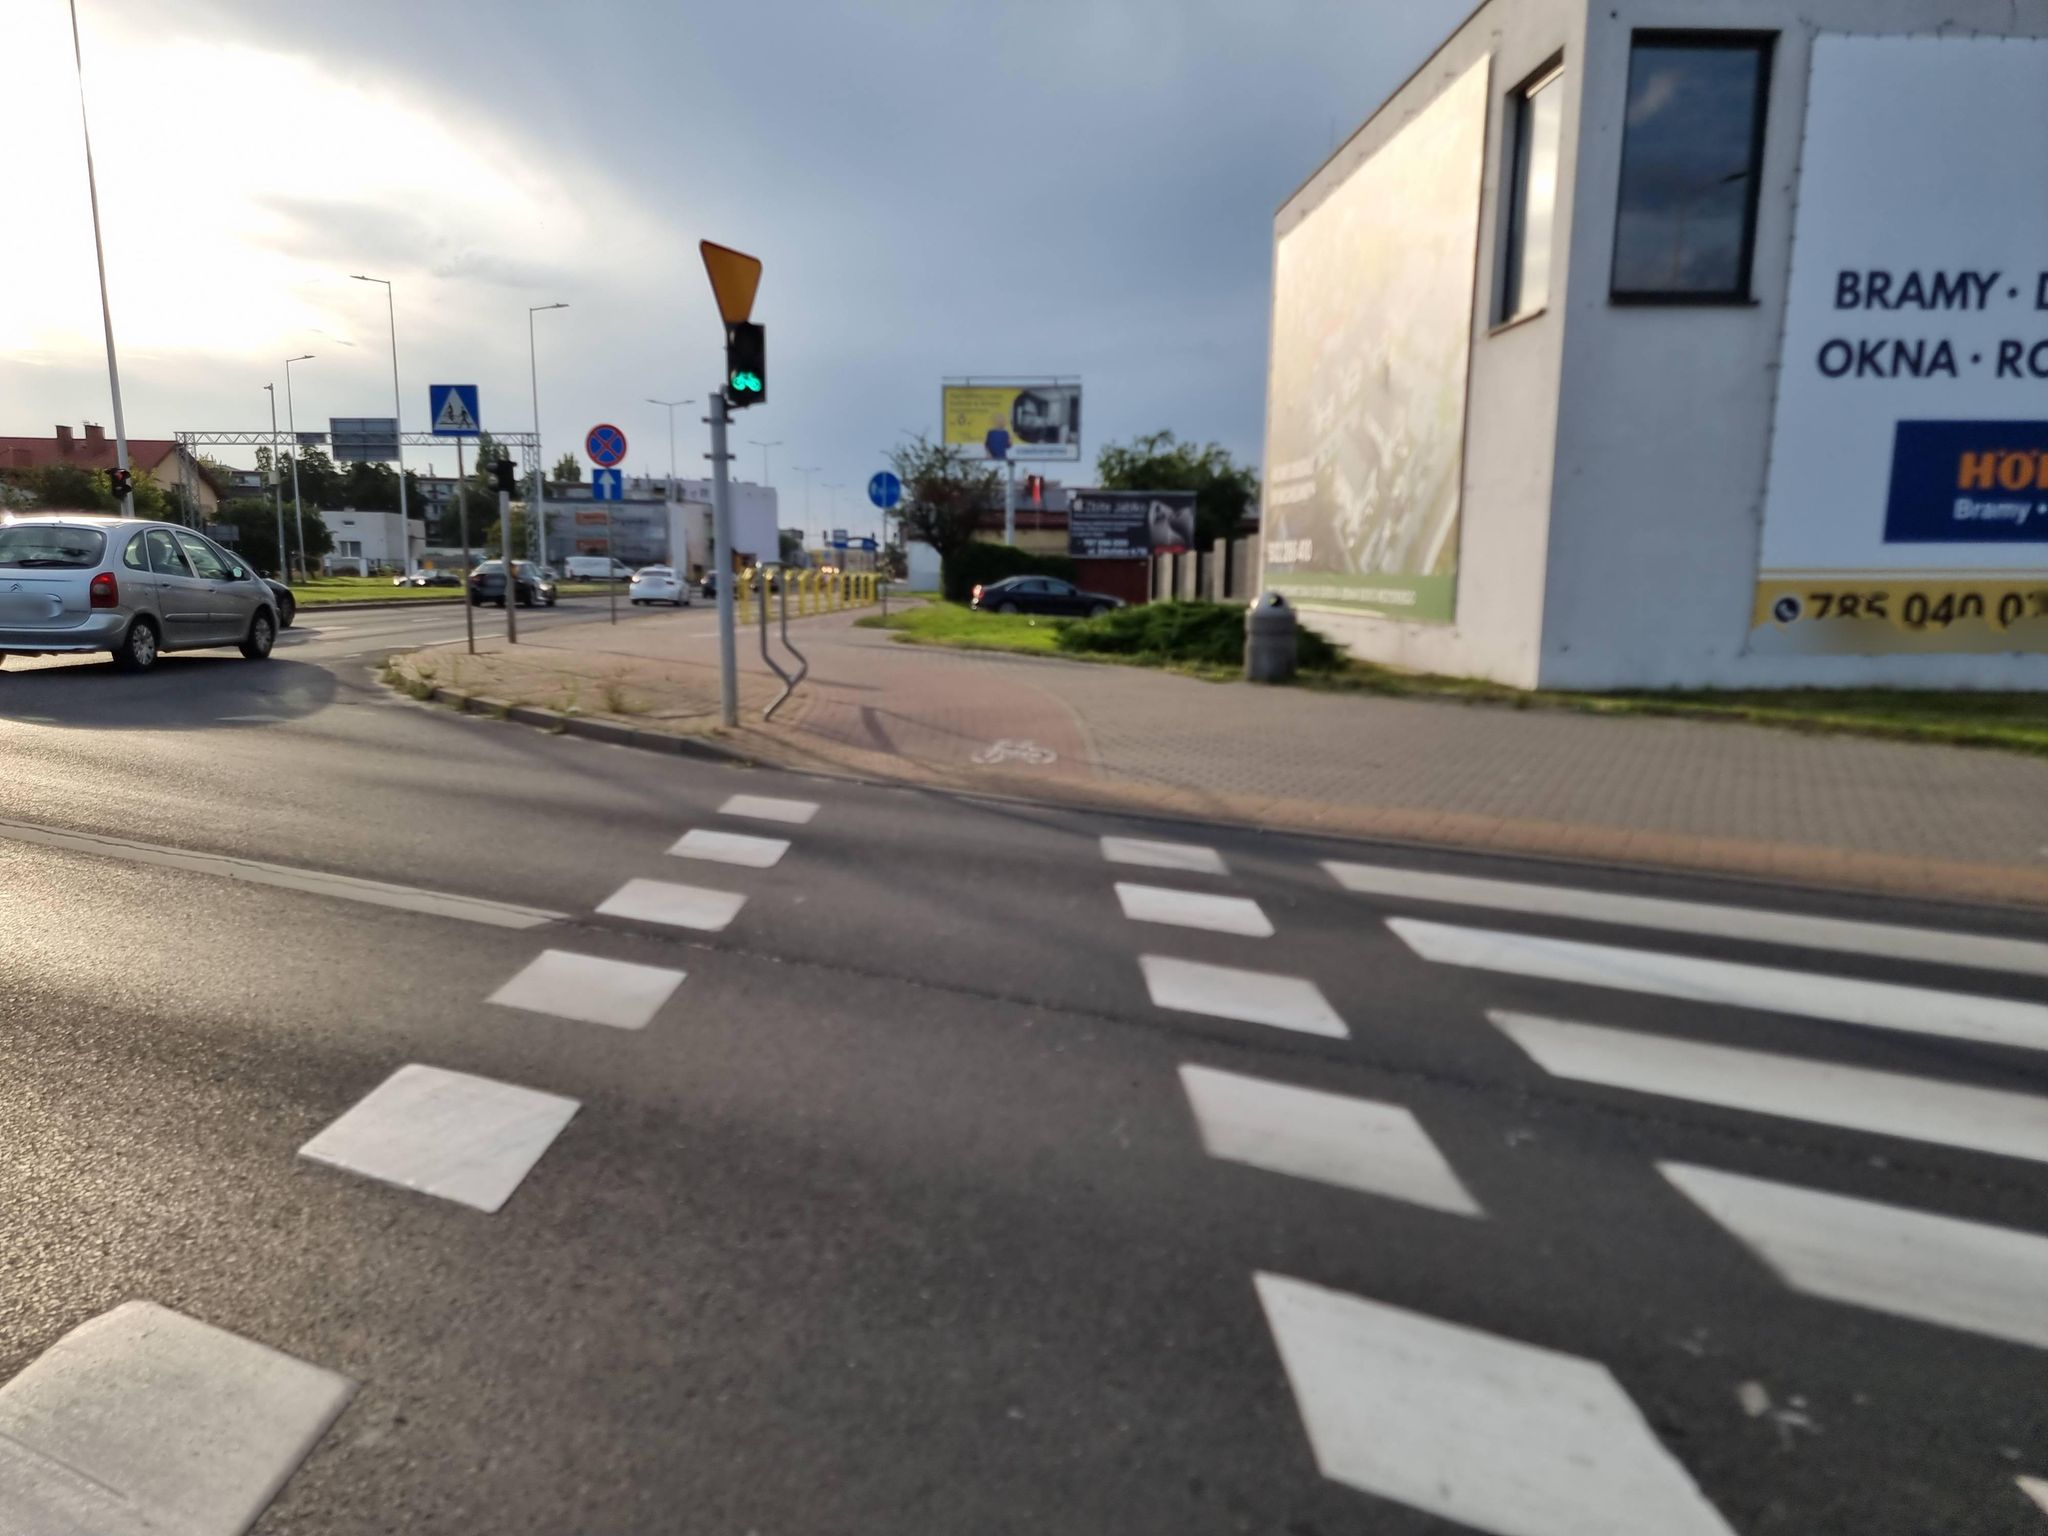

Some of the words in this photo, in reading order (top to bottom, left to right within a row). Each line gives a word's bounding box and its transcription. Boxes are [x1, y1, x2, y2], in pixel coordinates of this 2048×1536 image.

[1835, 270, 2001, 310] BRAMY
[1817, 338, 1958, 378] OKNA
[1953, 498, 2033, 525] Bramy
